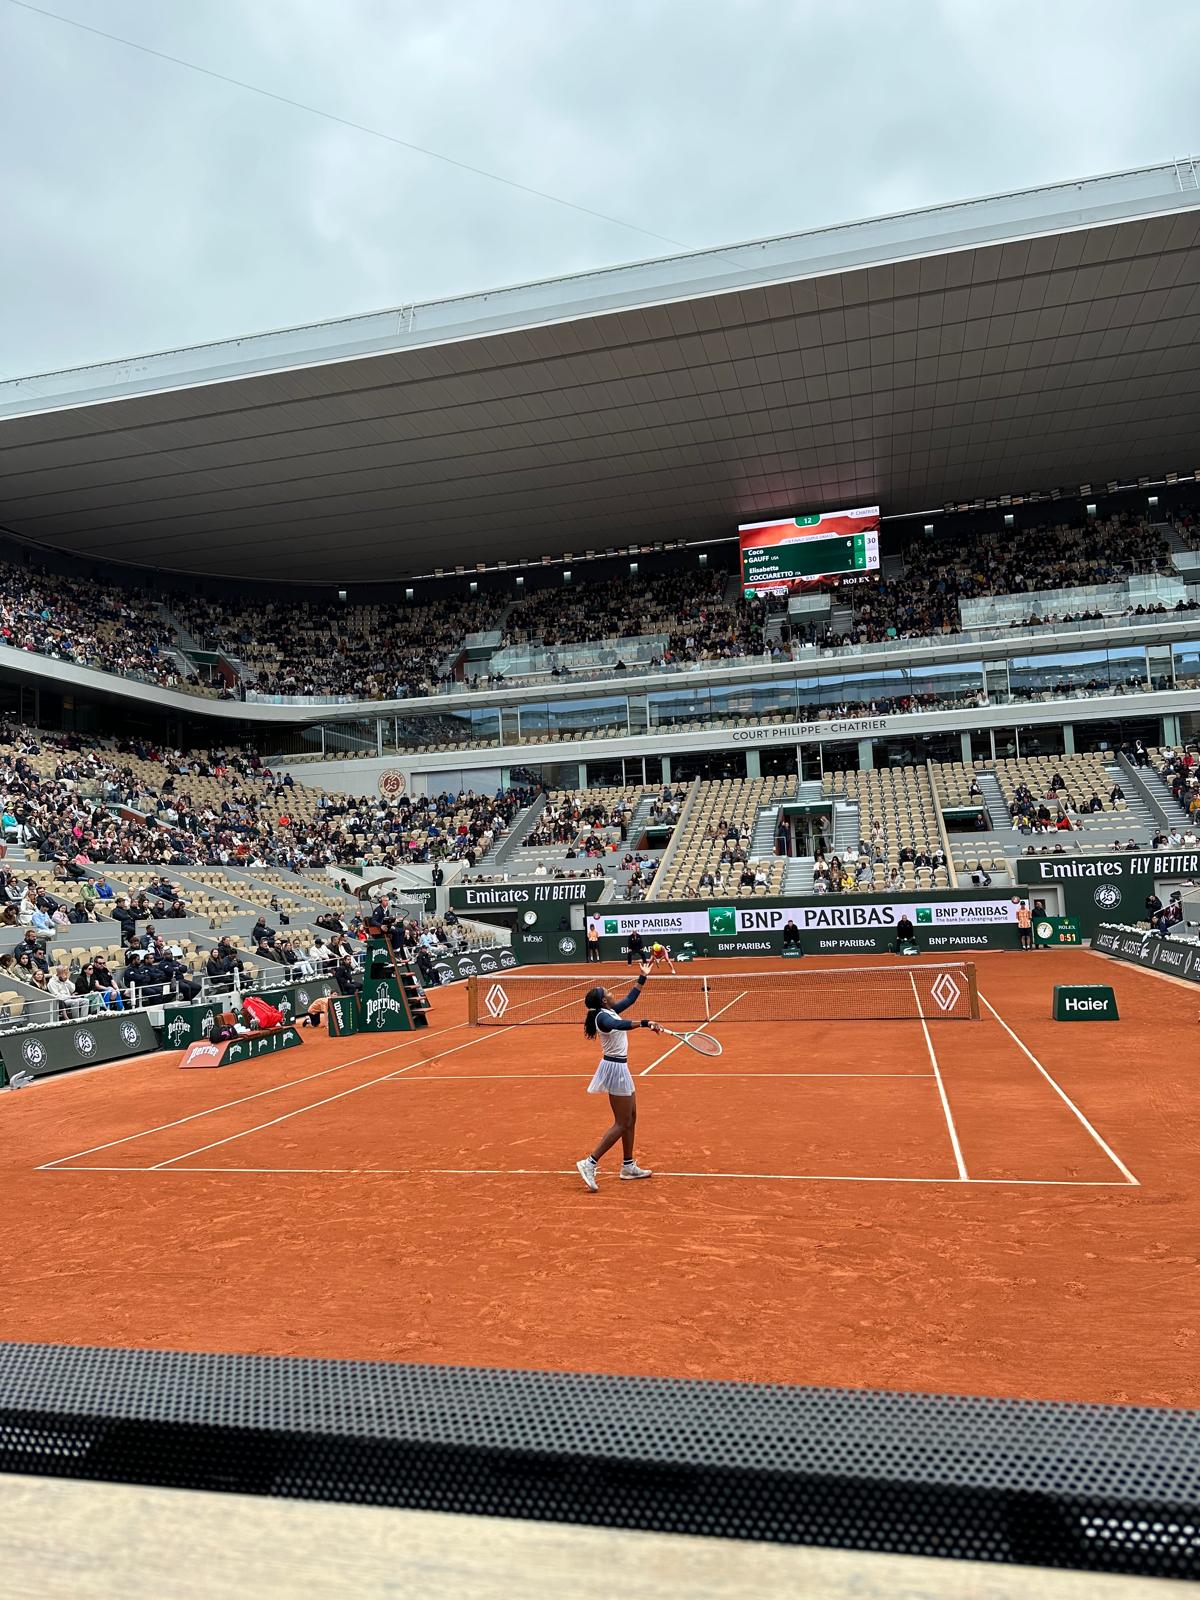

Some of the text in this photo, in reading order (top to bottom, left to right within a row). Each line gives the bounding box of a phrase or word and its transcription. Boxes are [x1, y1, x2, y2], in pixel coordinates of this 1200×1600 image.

[803, 517, 812, 525] 12
[748, 549, 764, 557] Coco
[748, 555, 769, 563] GAUFF
[868, 555, 877, 563] 30
[749, 565, 779, 574] Elisabetta
[749, 570, 793, 582] COCCIARETTO
[732, 729, 769, 741] COURT
[772, 725, 821, 737] PHILIPPE
[831, 720, 887, 733] CHATRIER
[1040, 855, 1198, 879] Emirates FLY BETTER
[466, 884, 586, 904] Emirates FLY BETTER
[935, 905, 1008, 917] BNP PARIBAS
[741, 906, 895, 929] BNP PARIBAS
[621, 917, 682, 930] BNP PARIBAS
[522, 934, 543, 944] Infosys
[820, 938, 876, 948] BNP PARIBAS
[929, 935, 988, 946] BNP PARIBAS
[1059, 933, 1076, 942] 0:51
[718, 941, 771, 951] BNP PARIBAS
[1160, 949, 1184, 966] RENAULT
[1065, 997, 1109, 1012] Haier
[333, 1001, 345, 1029] Wilson
